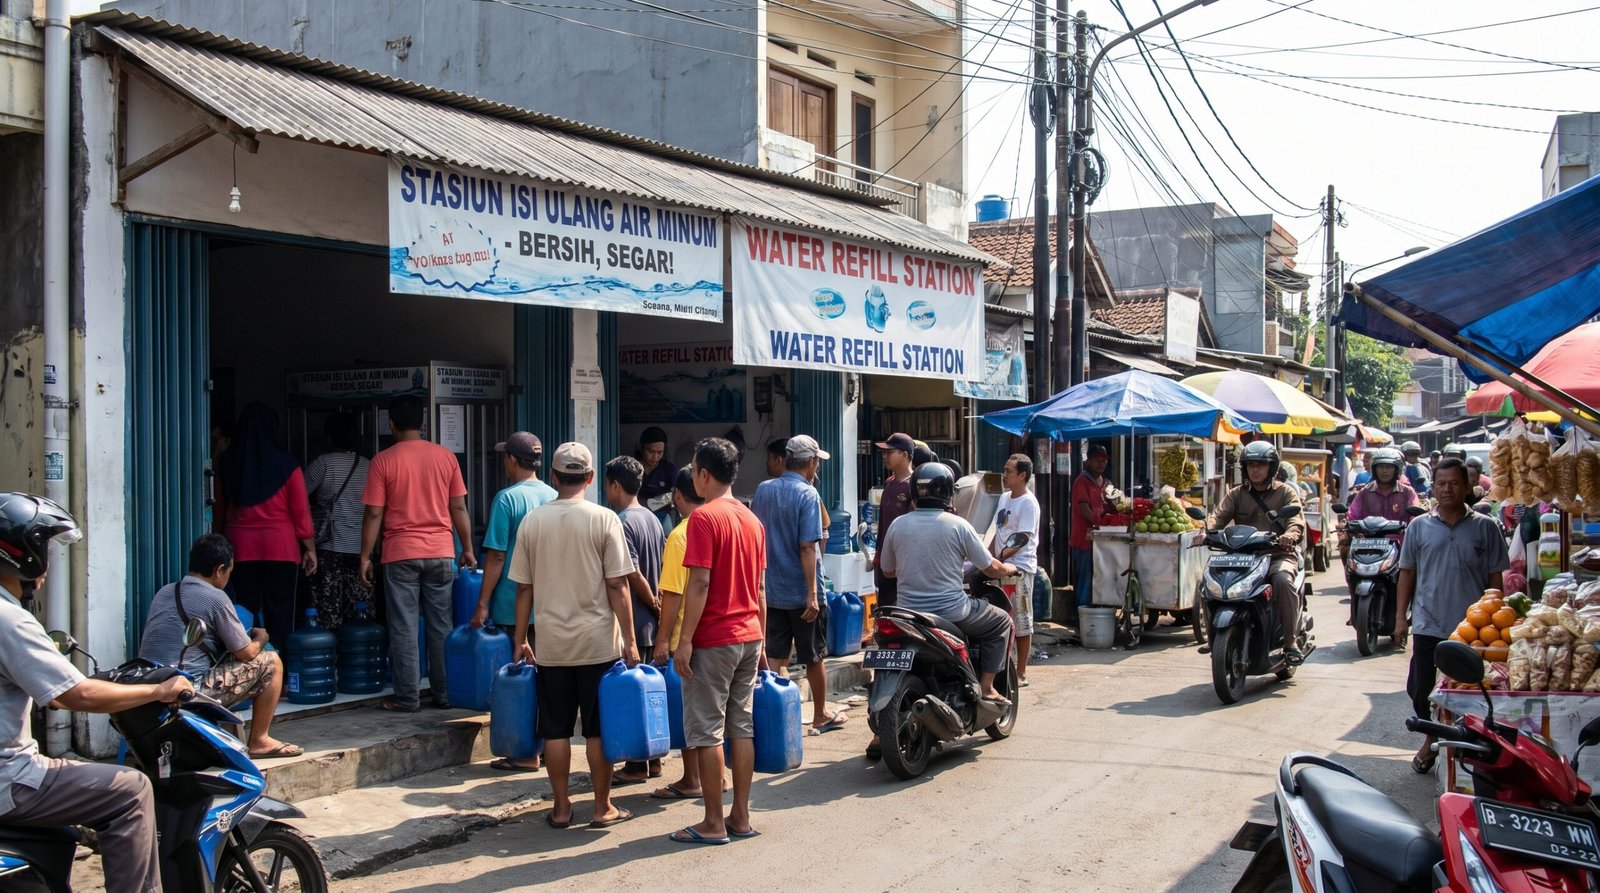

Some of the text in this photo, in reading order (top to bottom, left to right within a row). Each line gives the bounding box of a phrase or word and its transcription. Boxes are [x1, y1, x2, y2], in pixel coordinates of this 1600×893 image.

[400, 165, 717, 249] STASIUN ISI ULANG AIR MINUM
[518, 230, 601, 272] BERSIH,
[606, 242, 674, 275] SEGAR!
[746, 224, 976, 297] WATER REFILL STATION
[619, 349, 649, 366] ATER
[652, 347, 690, 364] REFILL
[770, 329, 964, 375] WATER REFILL STATION
[369, 369, 382, 380] AIR
[383, 368, 409, 379] MINUM
[866, 651, 872, 660] A
[876, 651, 896, 660] 3332
[1510, 813, 1554, 838] 3223
